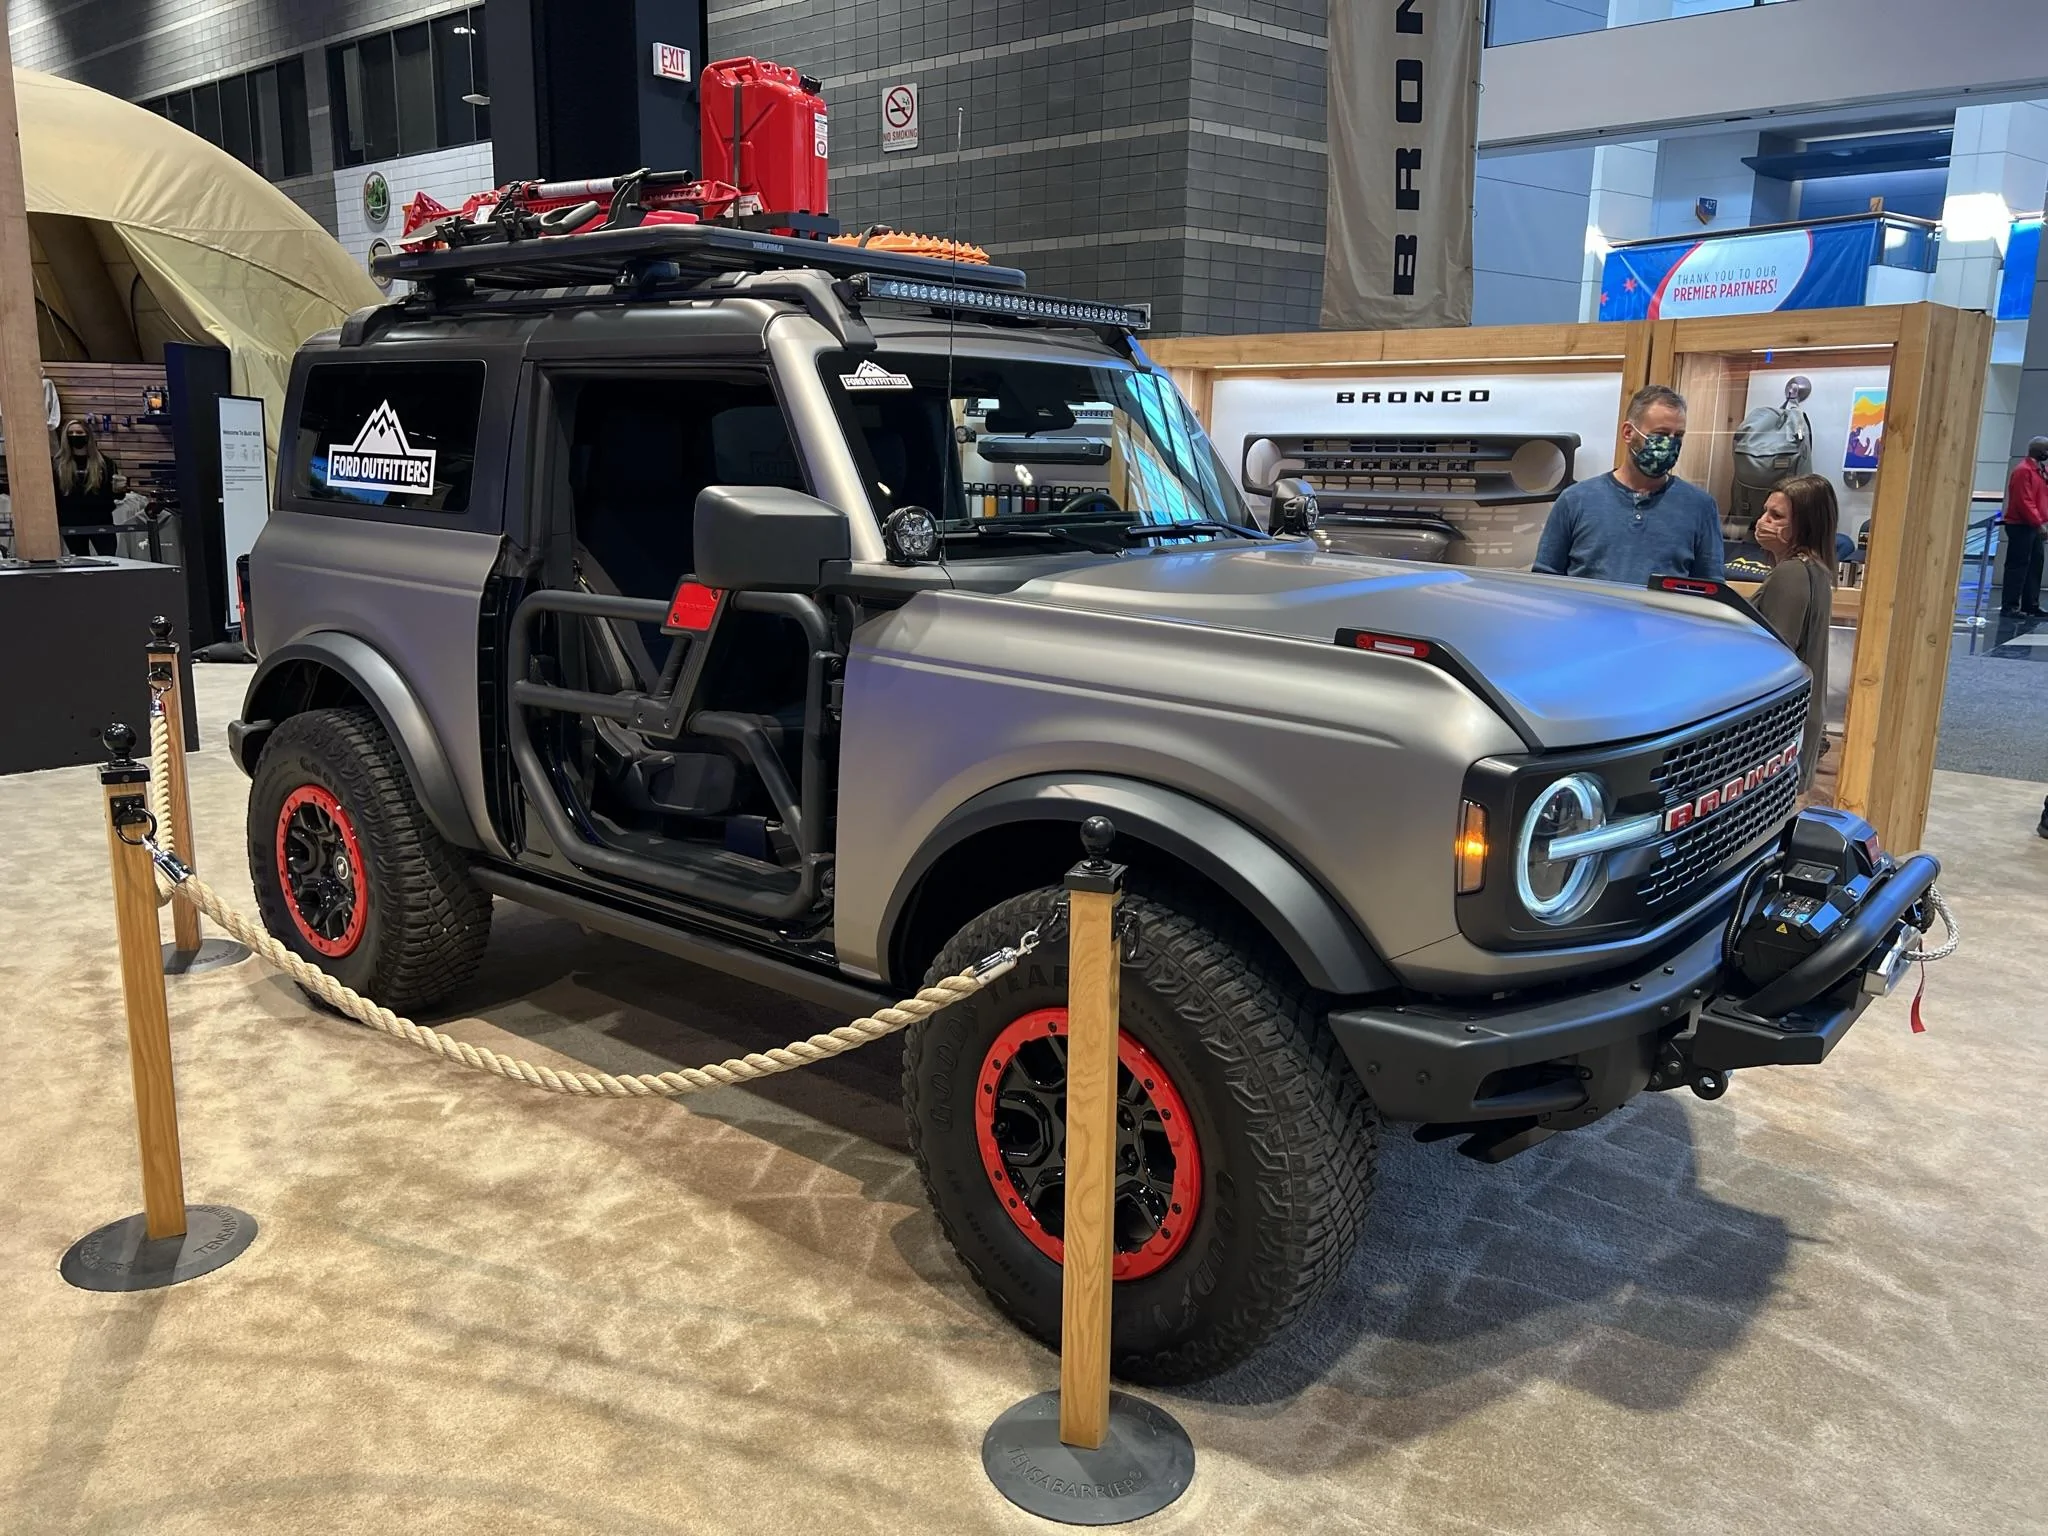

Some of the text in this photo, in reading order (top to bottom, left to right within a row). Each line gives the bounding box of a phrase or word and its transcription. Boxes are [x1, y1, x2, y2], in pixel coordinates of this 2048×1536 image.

[661, 46, 686, 71] EXIT
[883, 128, 918, 142] NO SMOKING
[1678, 265, 1777, 285] THANK YOU TO OUR
[1674, 278, 1778, 302] PREMIER PARTNERS!
[845, 377, 907, 386] FORD OUTFITTERS
[1336, 389, 1490, 404] BRONCO
[332, 455, 360, 478] FORD
[361, 457, 430, 483] OUTFITTERS
[1664, 743, 1798, 832] BRONCO
